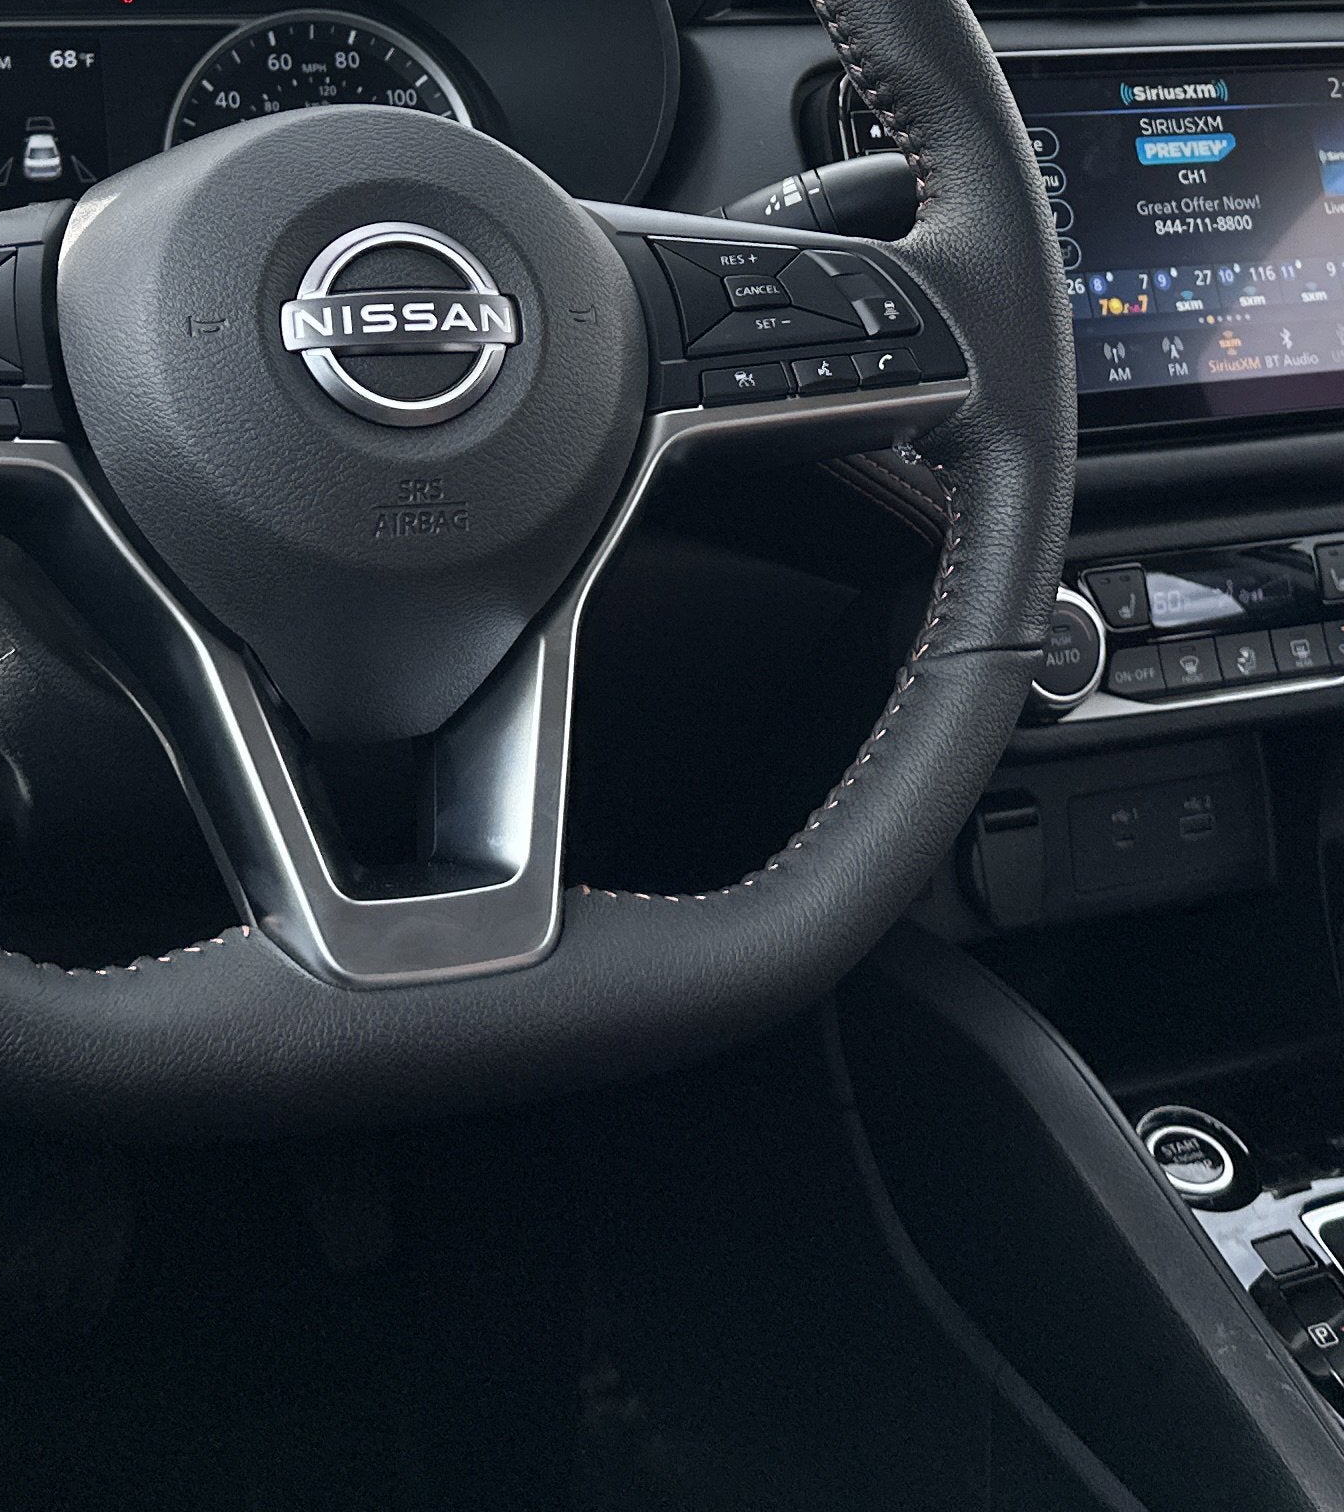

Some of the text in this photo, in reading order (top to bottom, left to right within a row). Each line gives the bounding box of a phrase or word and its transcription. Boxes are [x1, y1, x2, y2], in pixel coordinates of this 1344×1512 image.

[268, 53, 292, 70] 60
[335, 52, 360, 68] 80
[302, 63, 327, 74] MPH
[319, 85, 337, 97] 120
[387, 89, 417, 106] 100
[215, 91, 241, 108] 40
[1139, 115, 1224, 135] SIRIUSXM
[1144, 140, 1227, 159] PREVIEW
[1178, 169, 1208, 184] CH1
[1136, 194, 1262, 216] Great Offer Now!
[1155, 215, 1253, 235] 844-711-8800
[720, 254, 745, 266] RES
[1218, 269, 1234, 284] 10
[1249, 265, 1276, 282] 116
[1280, 265, 1296, 279] 11
[1326, 261, 1336, 277] 9
[1093, 278, 1102, 291] 8
[1139, 274, 1148, 290] 7
[1158, 274, 1167, 287] 9
[1194, 270, 1212, 286] 27
[736, 284, 780, 297] CANCEL
[1066, 278, 1086, 295] 26
[1239, 295, 1266, 307] sxm
[1301, 291, 1328, 302] sxm
[1175, 299, 1204, 312] sxm
[294, 302, 512, 339] NISSAN
[756, 318, 776, 329] SET
[1208, 356, 1262, 373] SiriusXM
[1264, 352, 1320, 369] BT Audio
[1108, 367, 1132, 382] AM
[1167, 362, 1189, 376] FM
[398, 478, 445, 503] SRS
[375, 508, 470, 538] AIRBAG
[1046, 648, 1080, 666] AUTO
[1161, 1138, 1200, 1159] START
[1314, 1326, 1328, 1344] P
